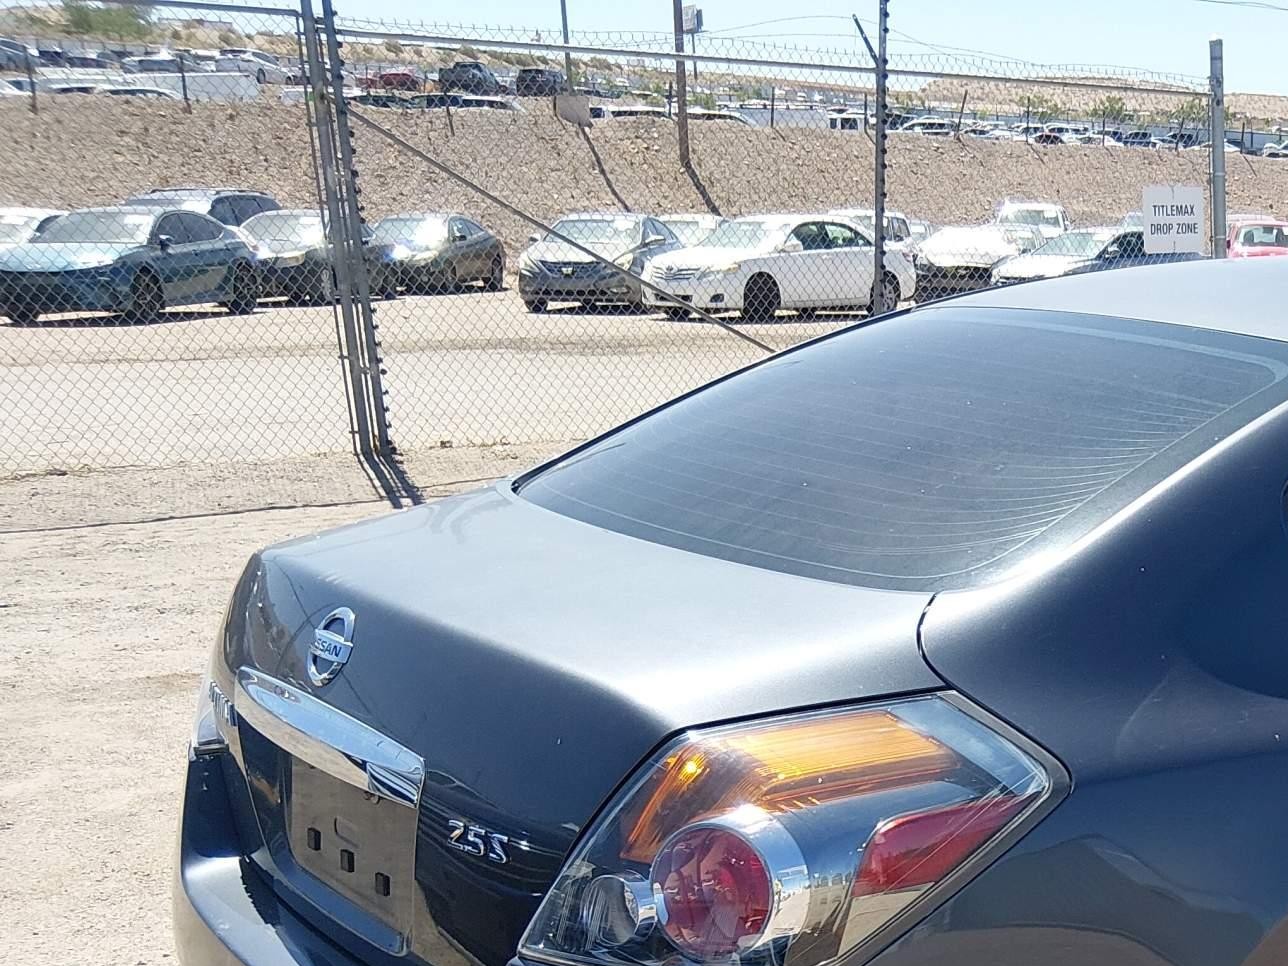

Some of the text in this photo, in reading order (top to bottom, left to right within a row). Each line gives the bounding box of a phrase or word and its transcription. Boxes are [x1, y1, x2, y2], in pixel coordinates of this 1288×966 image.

[1152, 204, 1195, 216] TITLEMAX
[1150, 222, 1199, 235] DROP ZONE
[309, 638, 342, 658] SSAN
